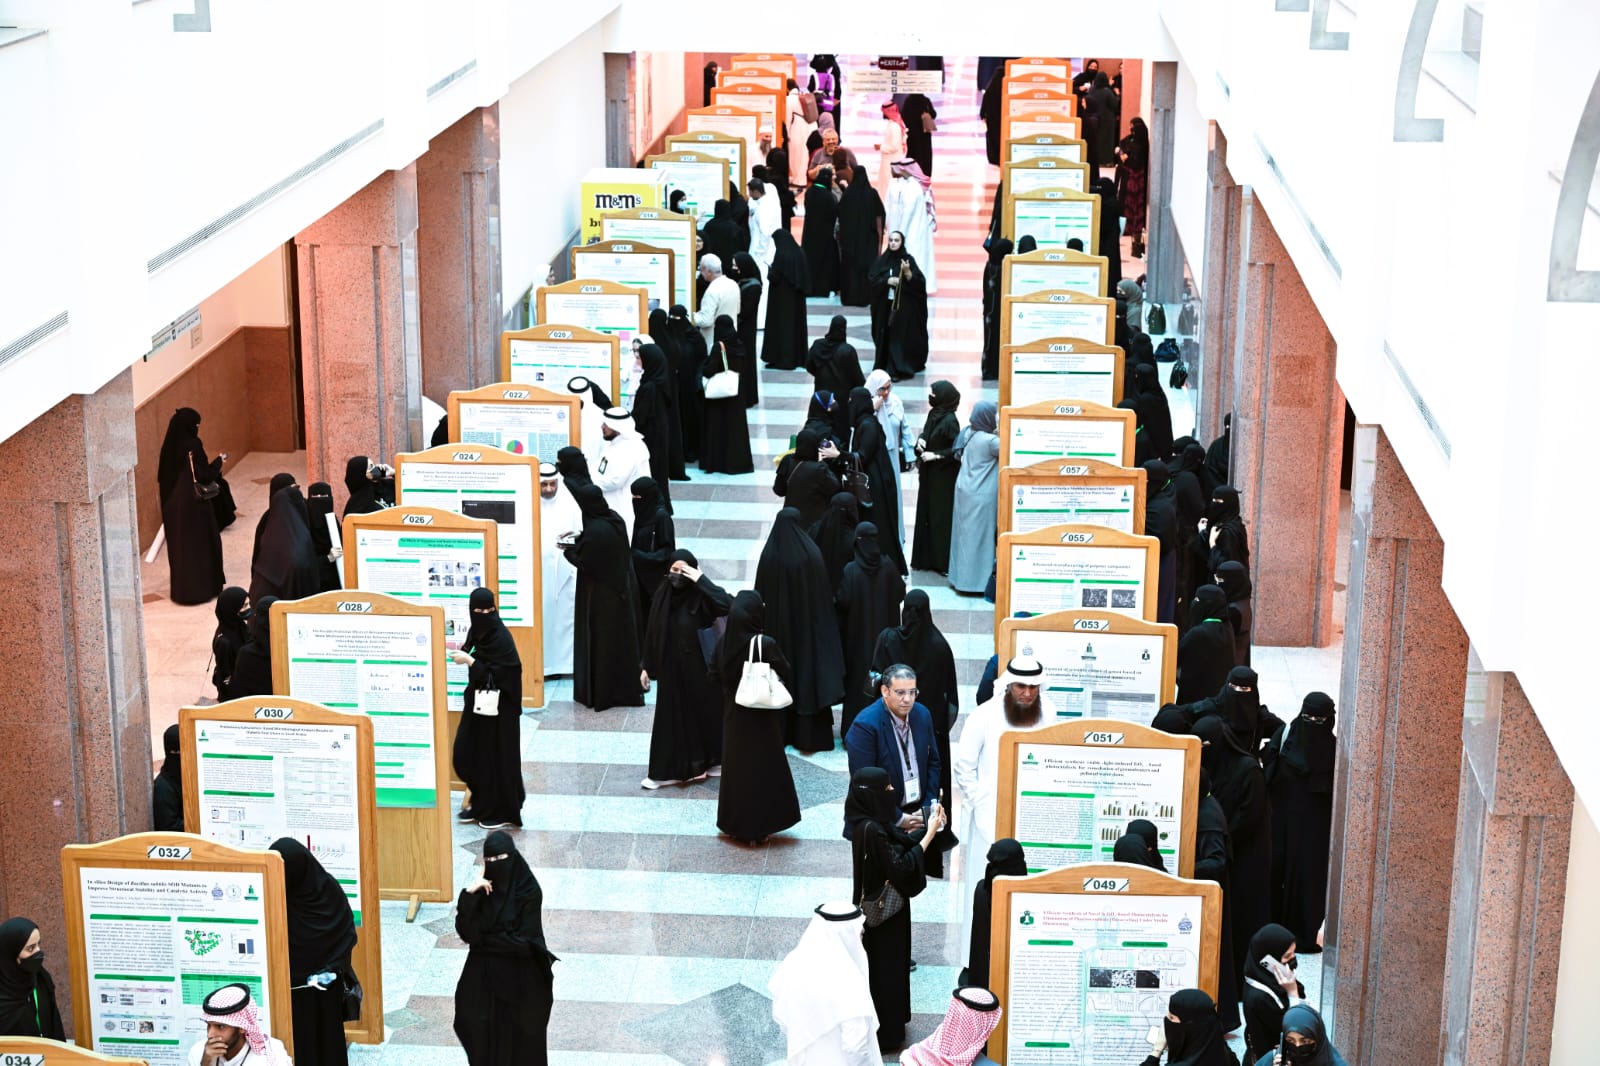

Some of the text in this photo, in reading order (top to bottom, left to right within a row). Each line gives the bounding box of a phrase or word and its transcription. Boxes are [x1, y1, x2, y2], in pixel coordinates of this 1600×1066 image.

[509, 391, 523, 399] 022
[1060, 406, 1075, 414] 059
[459, 453, 474, 461] 024
[1066, 466, 1081, 474] 057
[409, 516, 425, 525] 026
[1068, 534, 1085, 542] 055
[345, 603, 362, 612] 028
[1081, 621, 1100, 629] 053
[264, 708, 284, 718] 030
[1093, 733, 1112, 743] 051
[158, 847, 181, 858] 032
[1093, 879, 1116, 890] 049
[5, 1055, 32, 1066] 034
